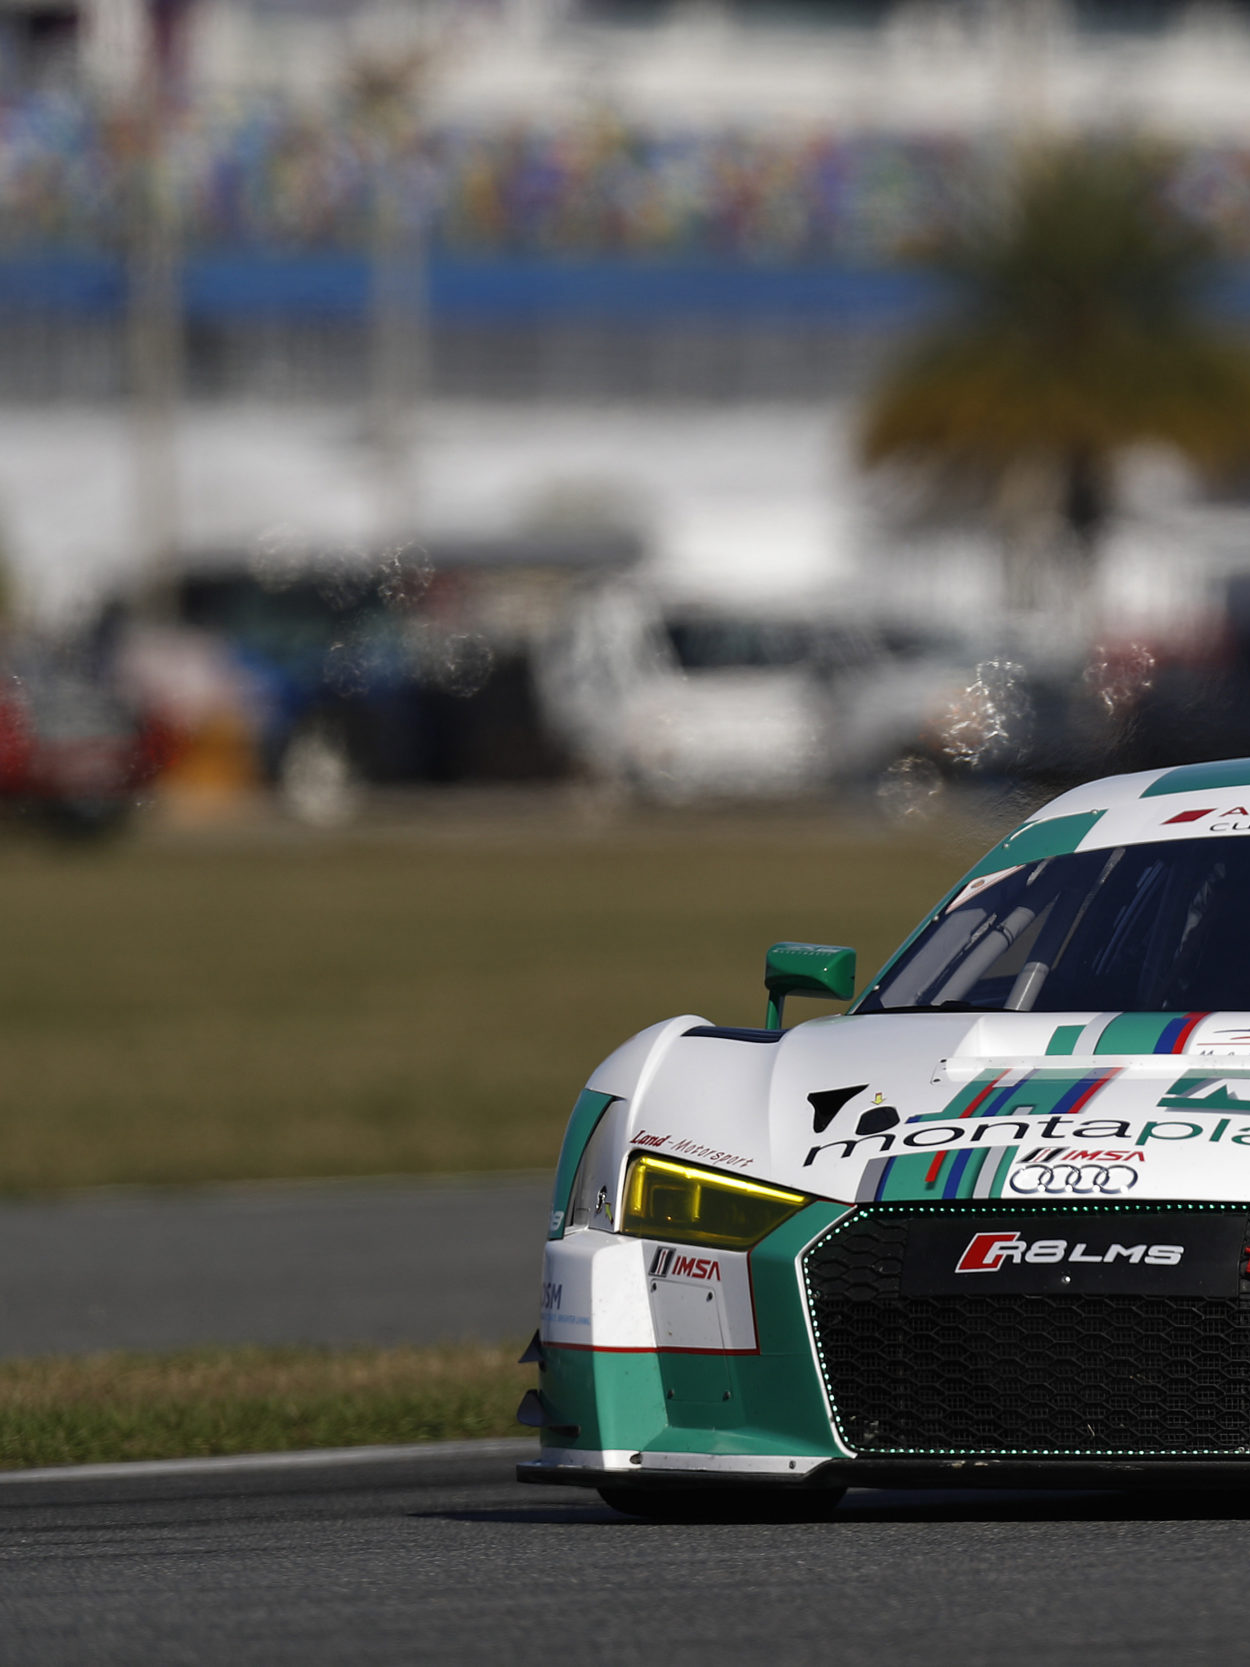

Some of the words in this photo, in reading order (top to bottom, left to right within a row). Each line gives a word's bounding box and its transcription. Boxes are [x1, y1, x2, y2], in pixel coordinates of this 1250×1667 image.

[1060, 1150, 1145, 1162] IMSA
[671, 1255, 721, 1282] IMSA
[542, 1281, 562, 1310] SM
